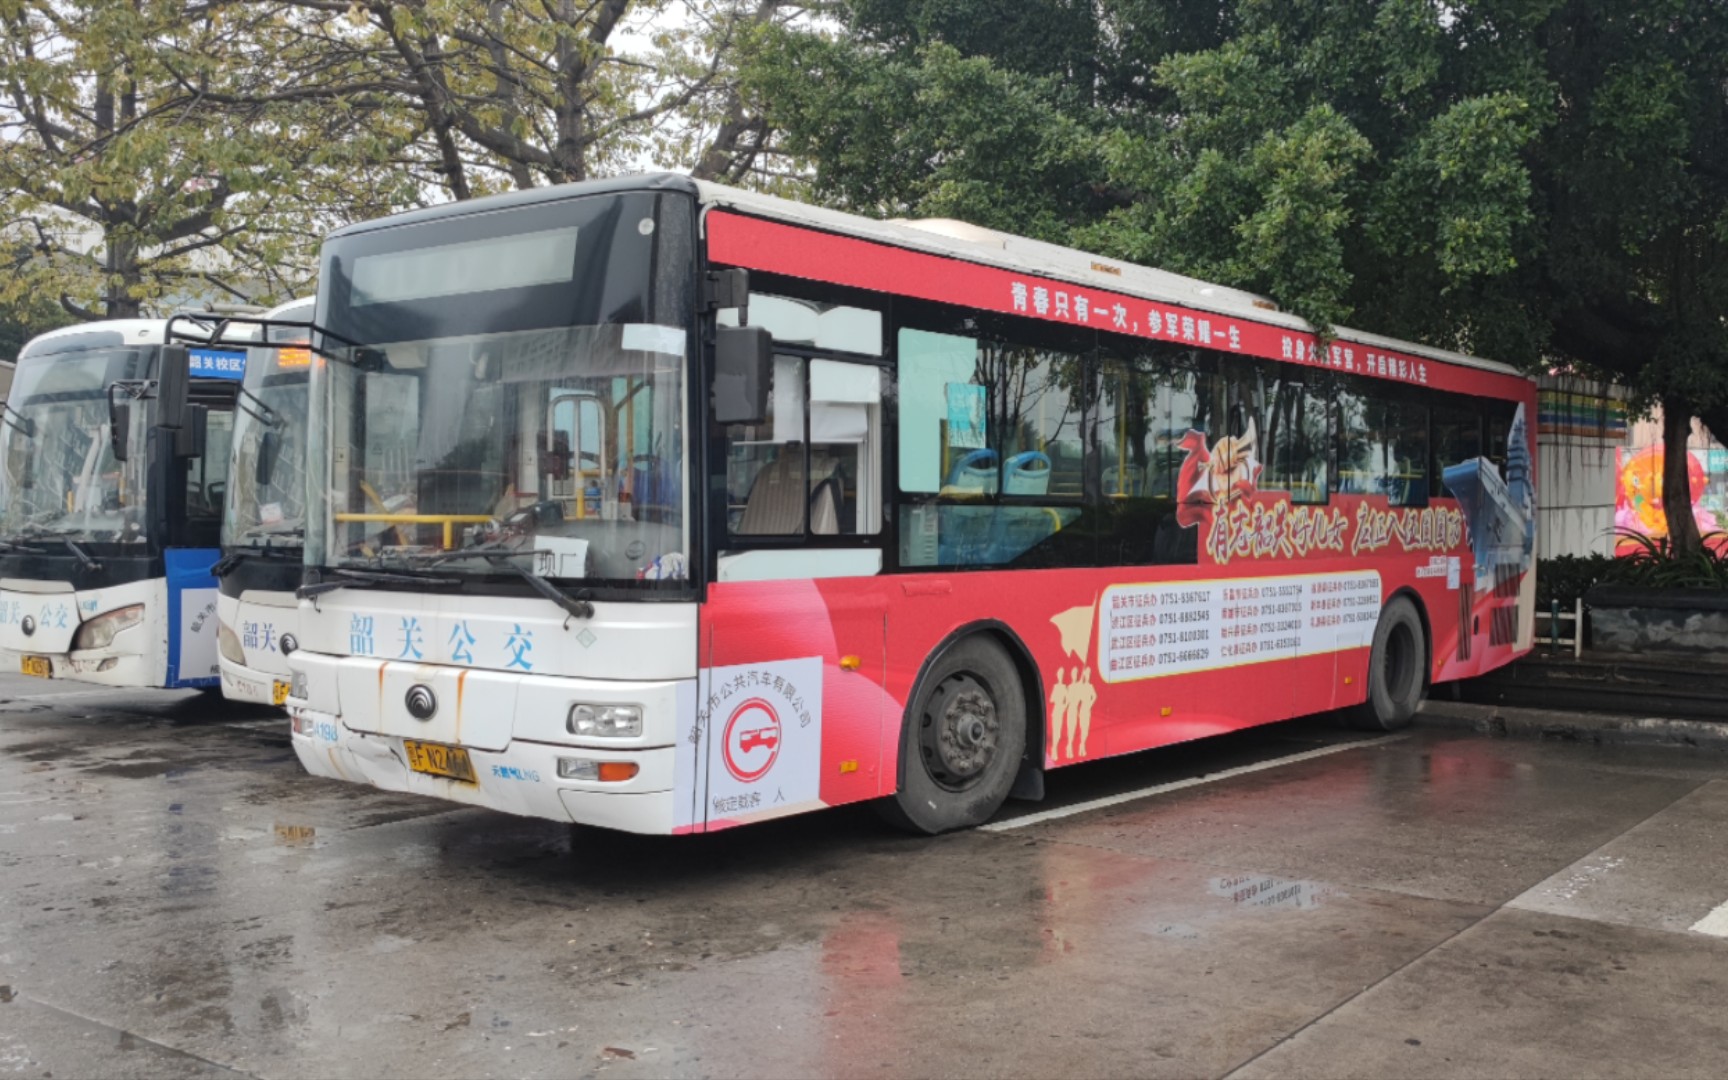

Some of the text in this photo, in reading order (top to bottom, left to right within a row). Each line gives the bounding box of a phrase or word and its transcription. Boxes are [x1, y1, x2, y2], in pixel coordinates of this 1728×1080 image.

[189, 354, 246, 372] 韶关校区
[40, 600, 68, 630] 公交
[241, 619, 278, 654] 韶关
[348, 612, 534, 672] 韶关公交
[773, 786, 786, 804] 人
